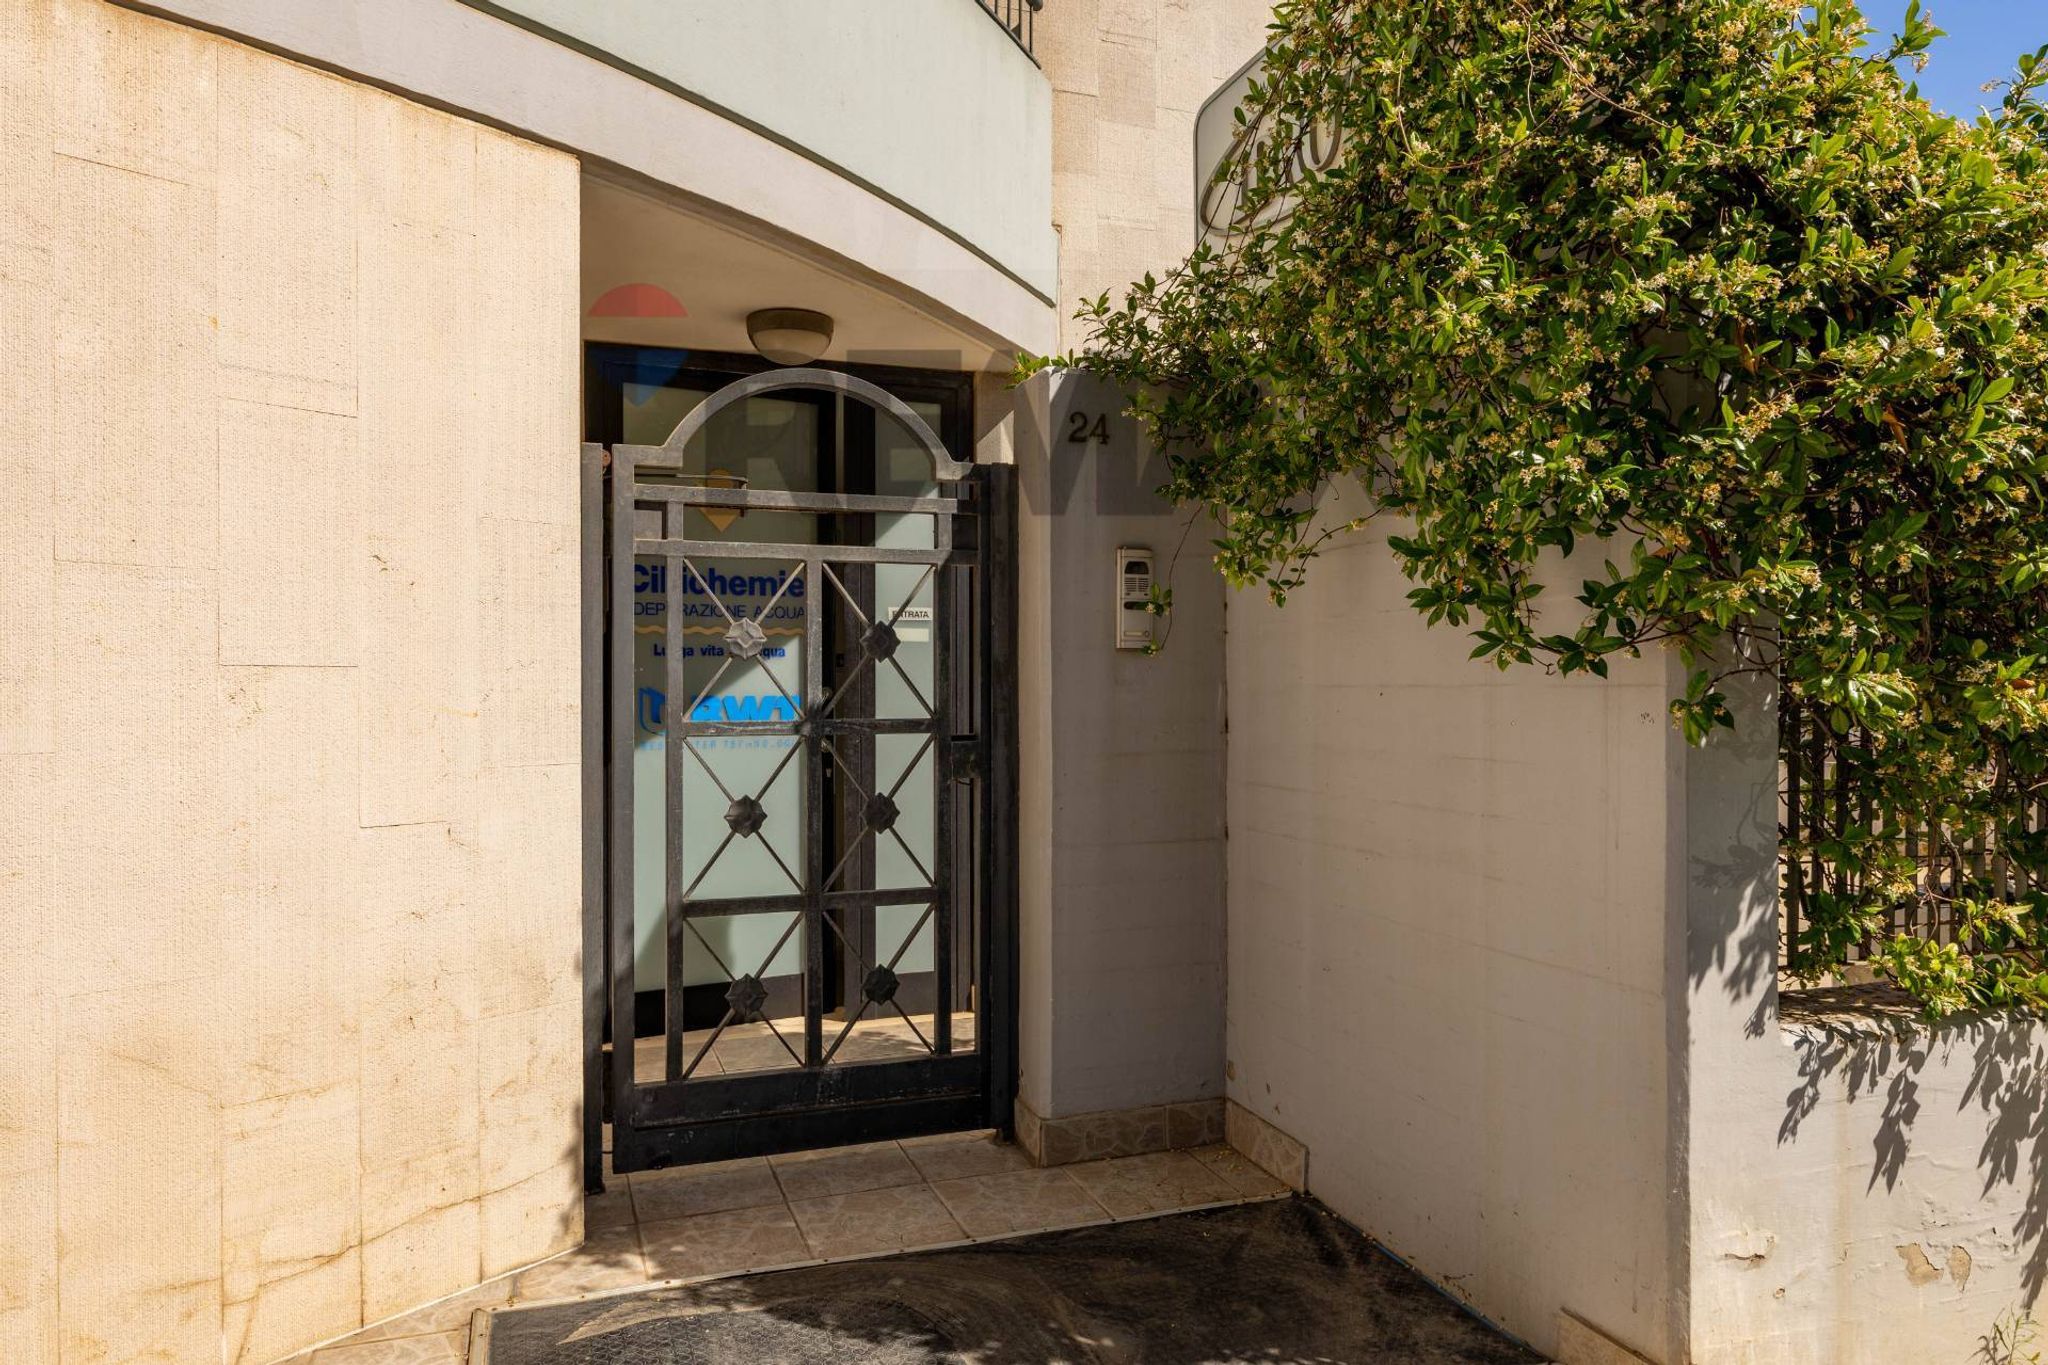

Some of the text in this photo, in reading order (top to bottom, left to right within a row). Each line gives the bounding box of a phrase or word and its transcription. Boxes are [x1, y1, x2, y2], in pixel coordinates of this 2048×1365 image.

[1068, 411, 1110, 445] 24
[634, 564, 805, 597] Cilichemie
[634, 602, 746, 618] DEPRAZIONE
[700, 644, 724, 656] vita
